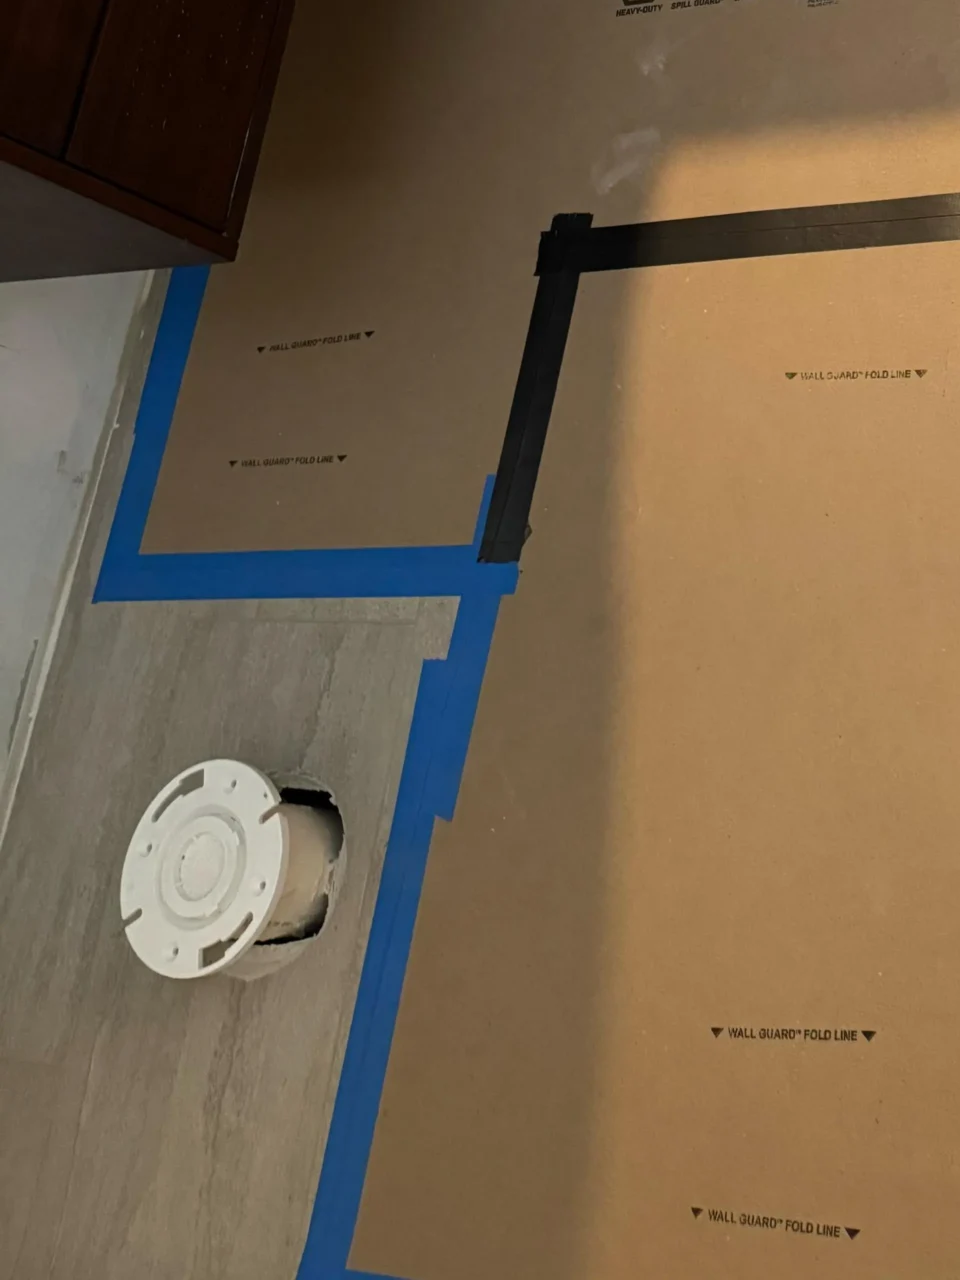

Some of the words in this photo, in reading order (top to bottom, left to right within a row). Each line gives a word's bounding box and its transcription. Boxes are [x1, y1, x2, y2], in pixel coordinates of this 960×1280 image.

[616, 4, 663, 18] HEAVY-DUTY
[670, 0, 692, 10] SPILL
[864, 370, 888, 379] FOLD
[890, 369, 911, 378] LINE
[728, 1026, 756, 1039] WALL
[804, 1029, 832, 1041] FOLD
[834, 1030, 858, 1041] LINE
[708, 1209, 736, 1224] WALL
[785, 1219, 814, 1234] FOLD
[816, 1224, 840, 1238] LINE
